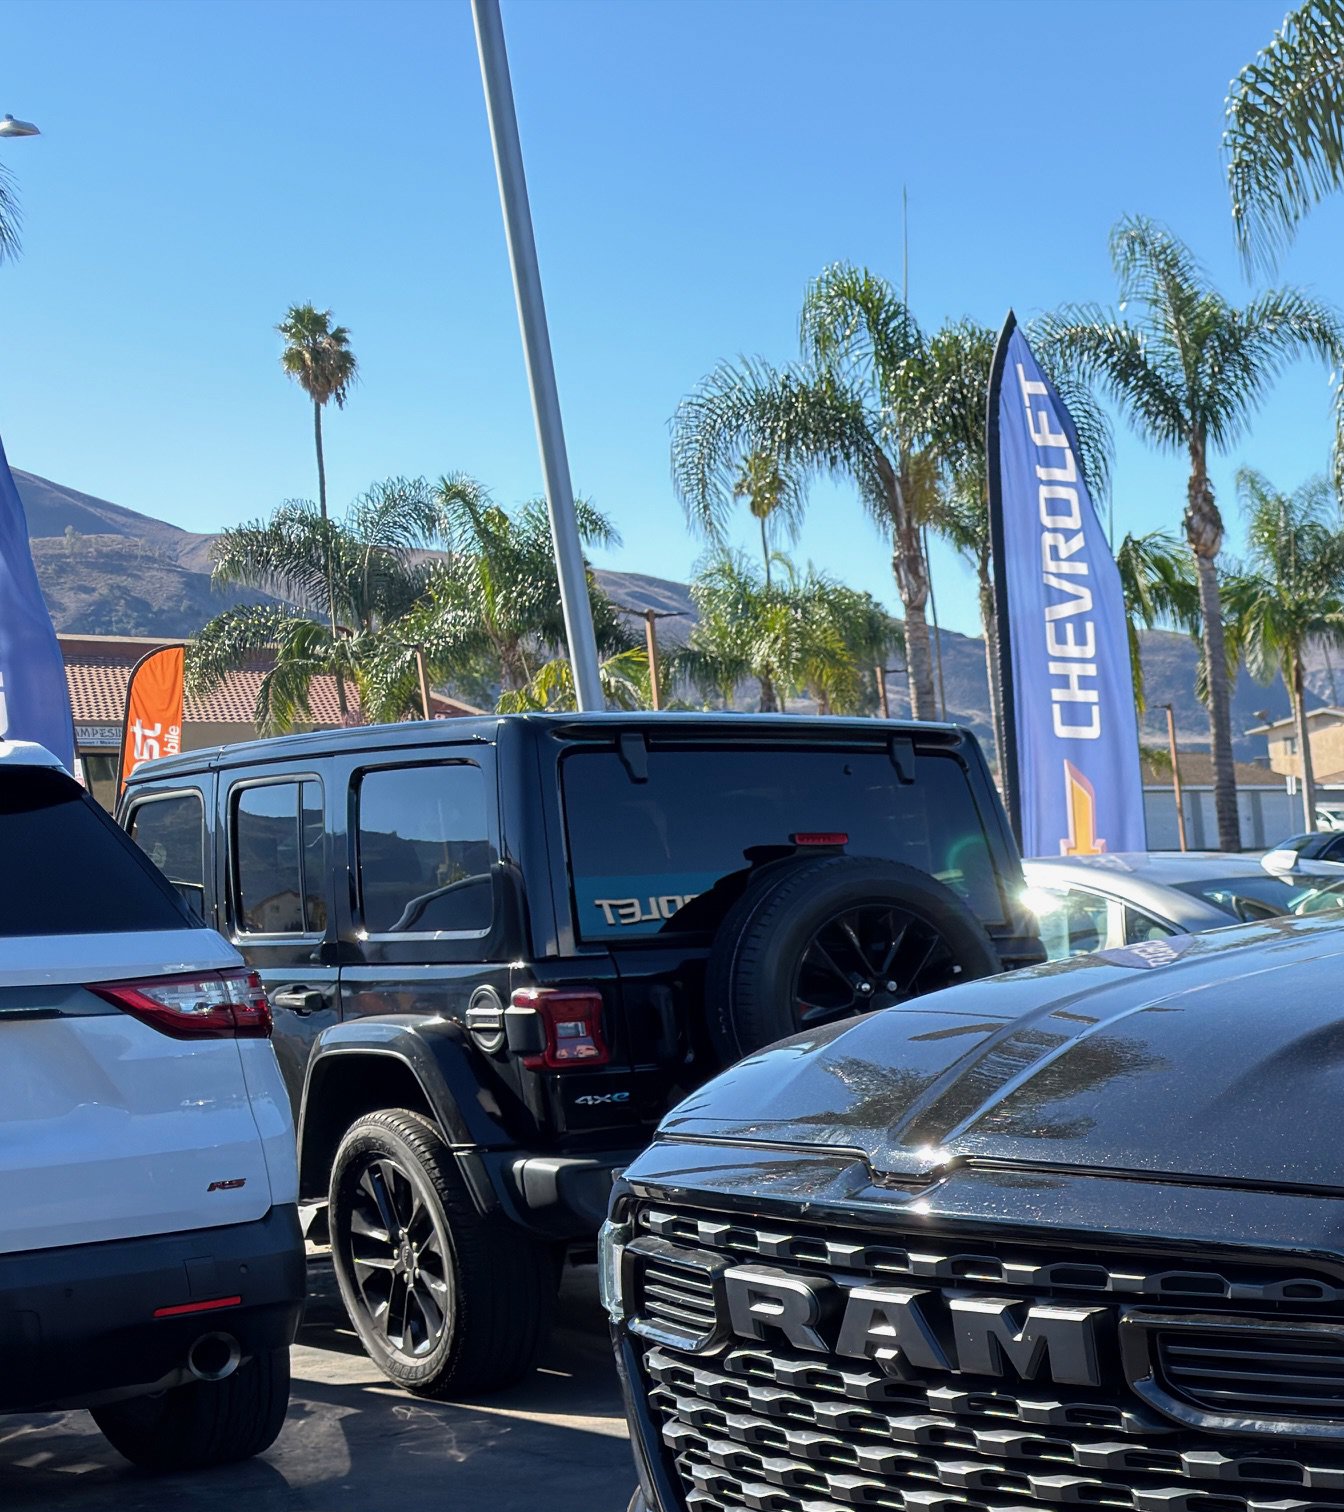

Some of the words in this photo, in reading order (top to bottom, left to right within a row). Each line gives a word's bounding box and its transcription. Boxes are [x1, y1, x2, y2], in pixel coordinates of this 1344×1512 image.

[1015, 362, 1101, 740] CHEVROLET
[574, 1091, 630, 1106] 4xe
[724, 1263, 1110, 1387] RAM
